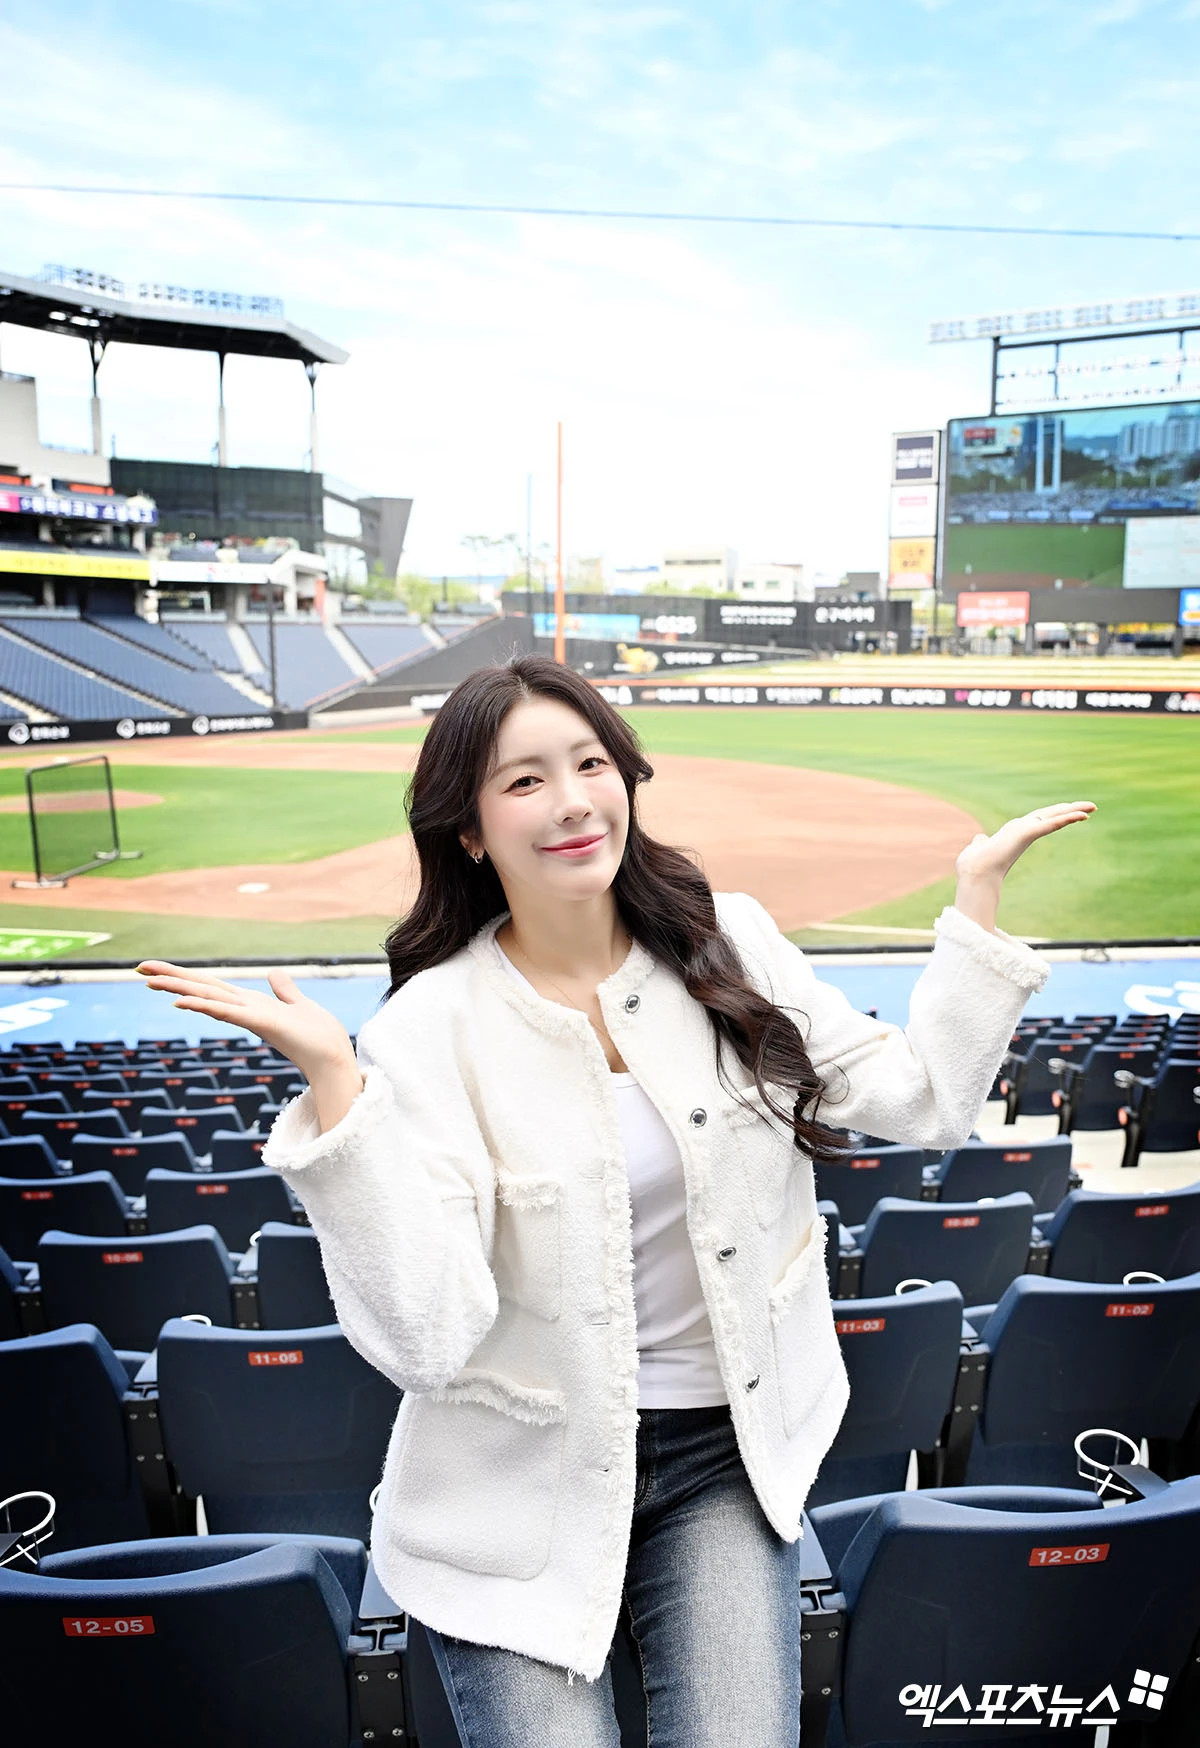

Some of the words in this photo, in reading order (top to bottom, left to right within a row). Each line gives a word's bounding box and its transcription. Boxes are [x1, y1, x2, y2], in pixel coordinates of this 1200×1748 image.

[1111, 1304, 1150, 1316] 11-02
[840, 1320, 880, 1332] 11-03
[253, 1353, 298, 1365] 11-05
[1037, 1547, 1100, 1564] 12-03
[71, 1619, 144, 1634] 12-05
